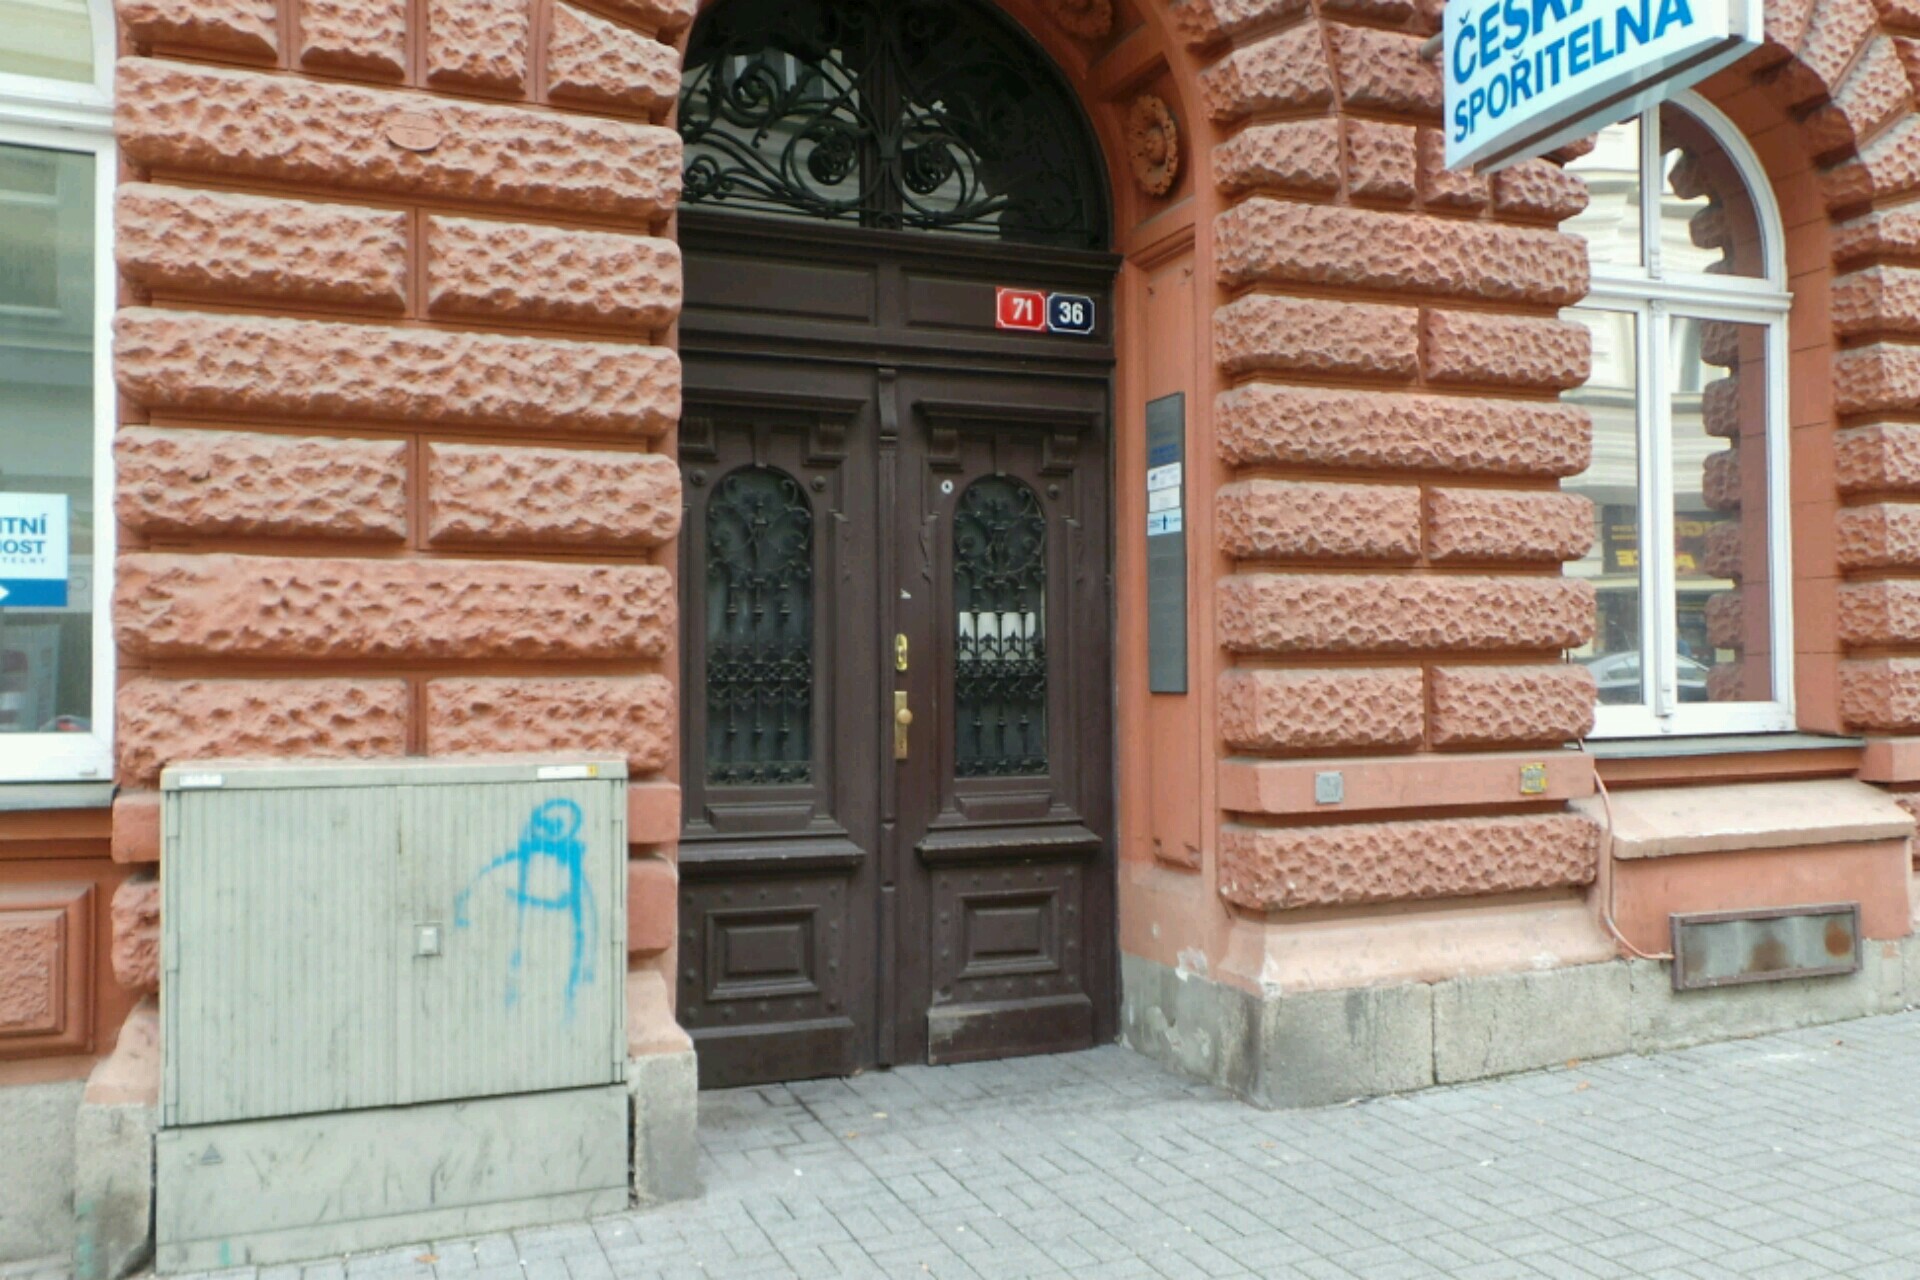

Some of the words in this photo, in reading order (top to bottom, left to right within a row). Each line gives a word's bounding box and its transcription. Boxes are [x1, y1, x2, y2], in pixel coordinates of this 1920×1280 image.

[1454, 0, 1694, 143] SPOŘITELNA
[1013, 297, 1033, 321] 71
[1060, 301, 1083, 324] 36
[0, 540, 45, 554] OST
